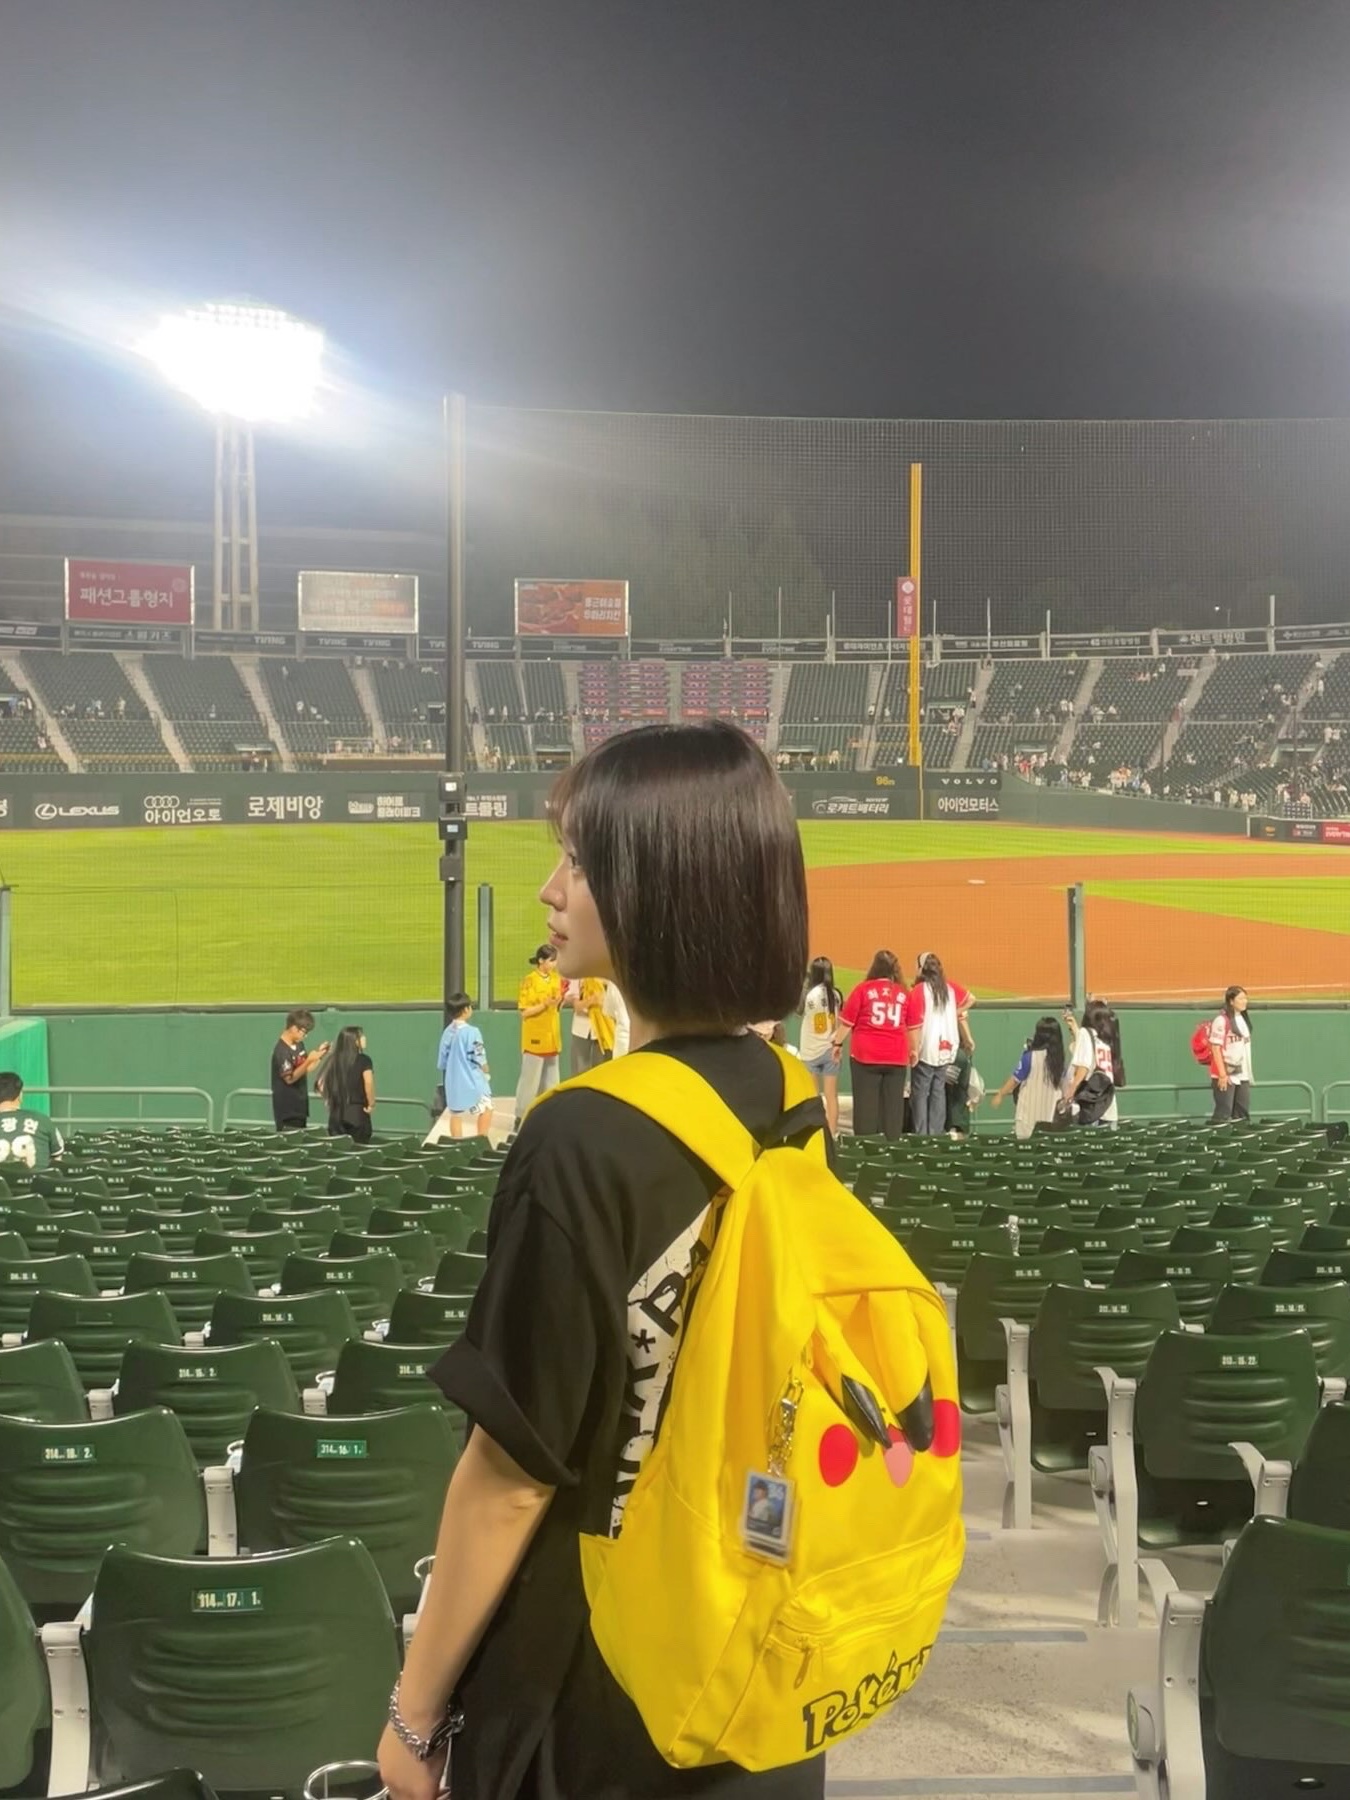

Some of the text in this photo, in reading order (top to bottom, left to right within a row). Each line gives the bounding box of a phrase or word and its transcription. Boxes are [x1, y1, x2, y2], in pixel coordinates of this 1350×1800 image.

[254, 636, 285, 646] TVING
[318, 637, 391, 647] TVING TVING
[472, 641, 499, 649] TVING
[248, 796, 323, 820] 로제비앙
[827, 802, 889, 814] 로케트배터리
[938, 797, 999, 812] 아이언모터스
[59, 806, 119, 816] LEXUS
[145, 808, 222, 824] 아이언오토
[871, 1001, 902, 1028] 54
